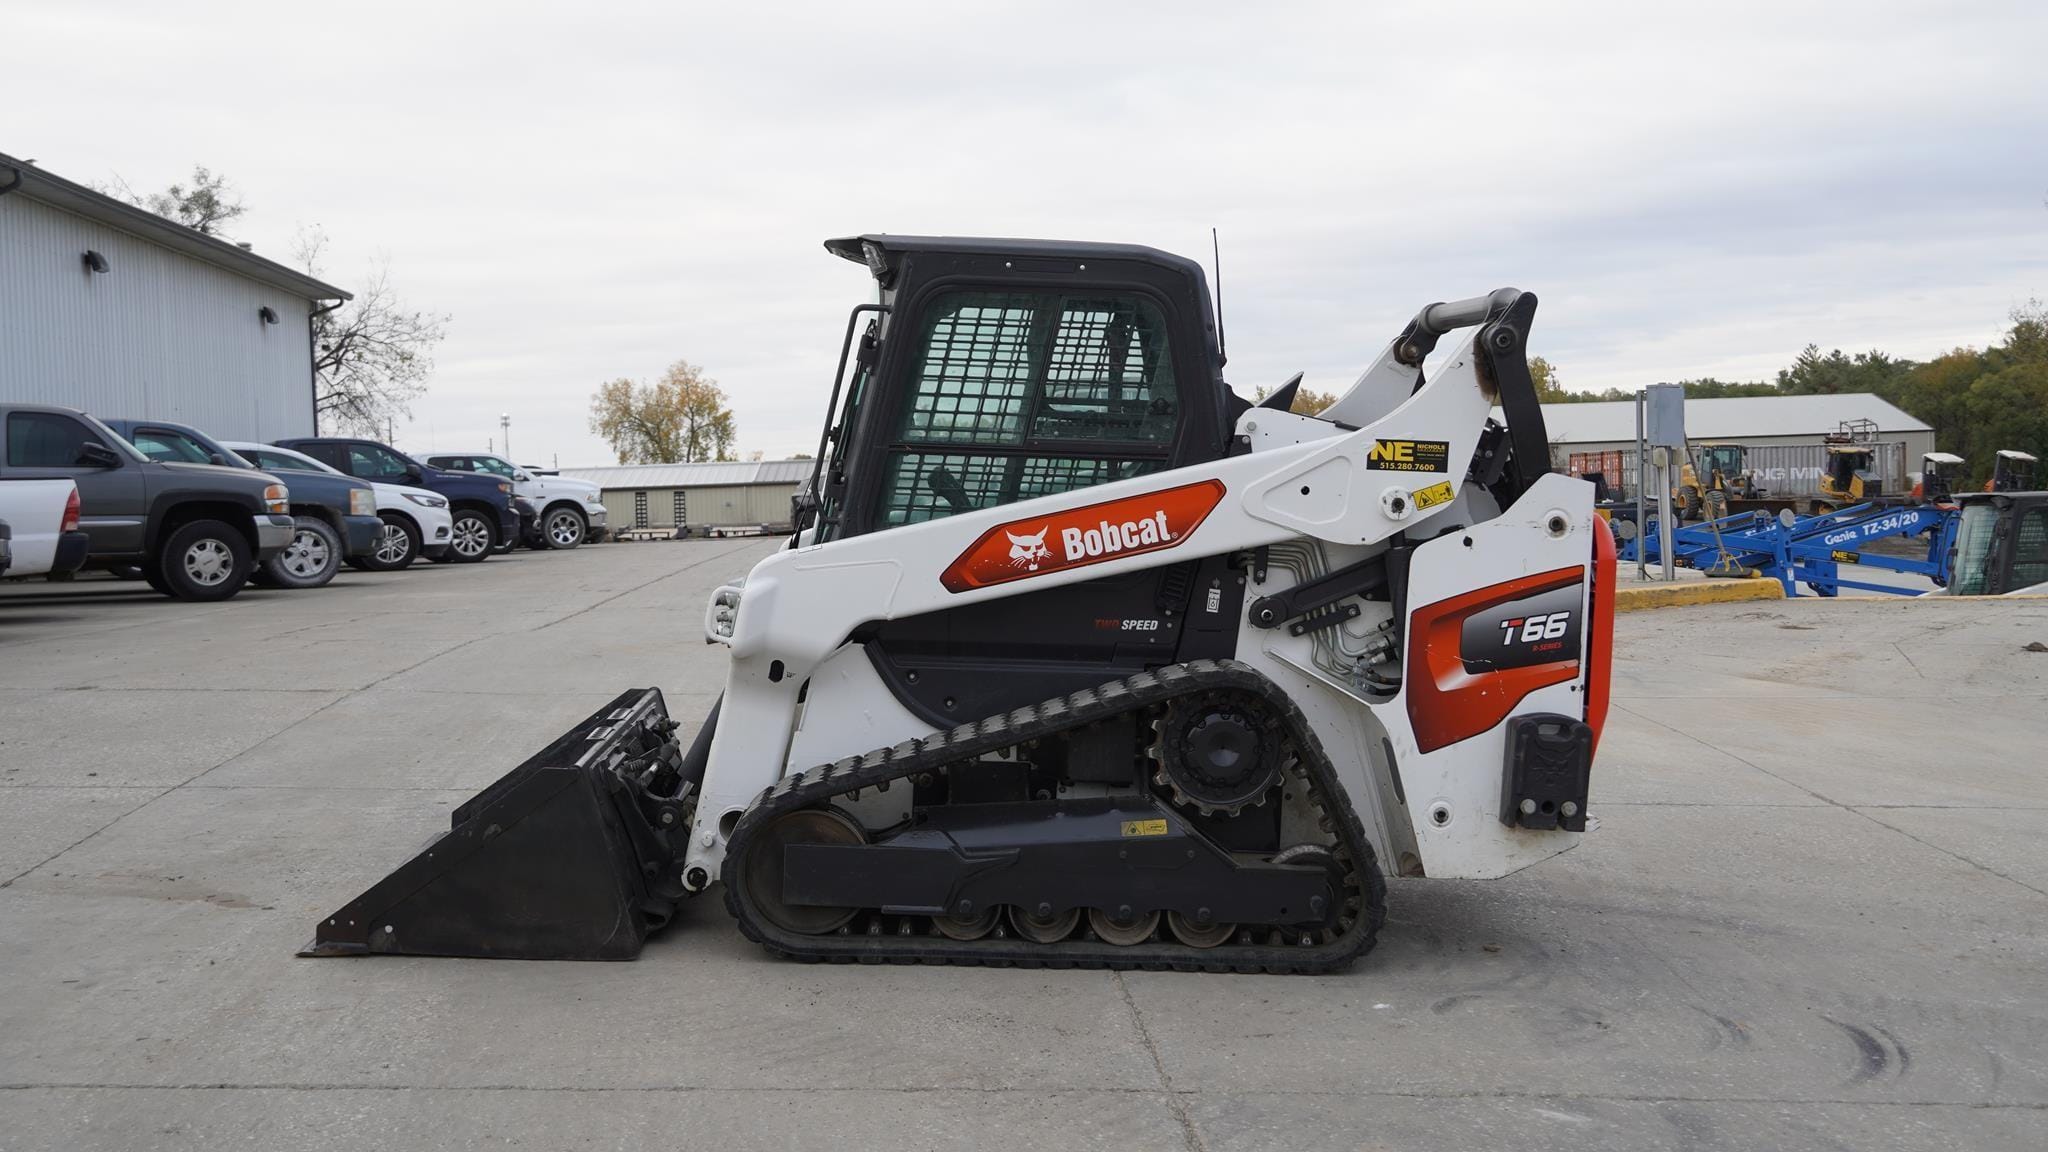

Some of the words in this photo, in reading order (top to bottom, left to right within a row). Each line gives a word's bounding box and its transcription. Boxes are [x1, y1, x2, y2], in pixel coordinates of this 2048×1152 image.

[1370, 441, 1415, 461] NE
[1380, 462, 1435, 471] 515.280.7600
[1061, 510, 1171, 561] Bobcat
[1824, 530, 1858, 545] Genie
[1862, 511, 1919, 536] TZ-34/20
[1095, 619, 1120, 629] TWO
[1121, 619, 1159, 630] SPEED
[1501, 611, 1570, 645] T66
